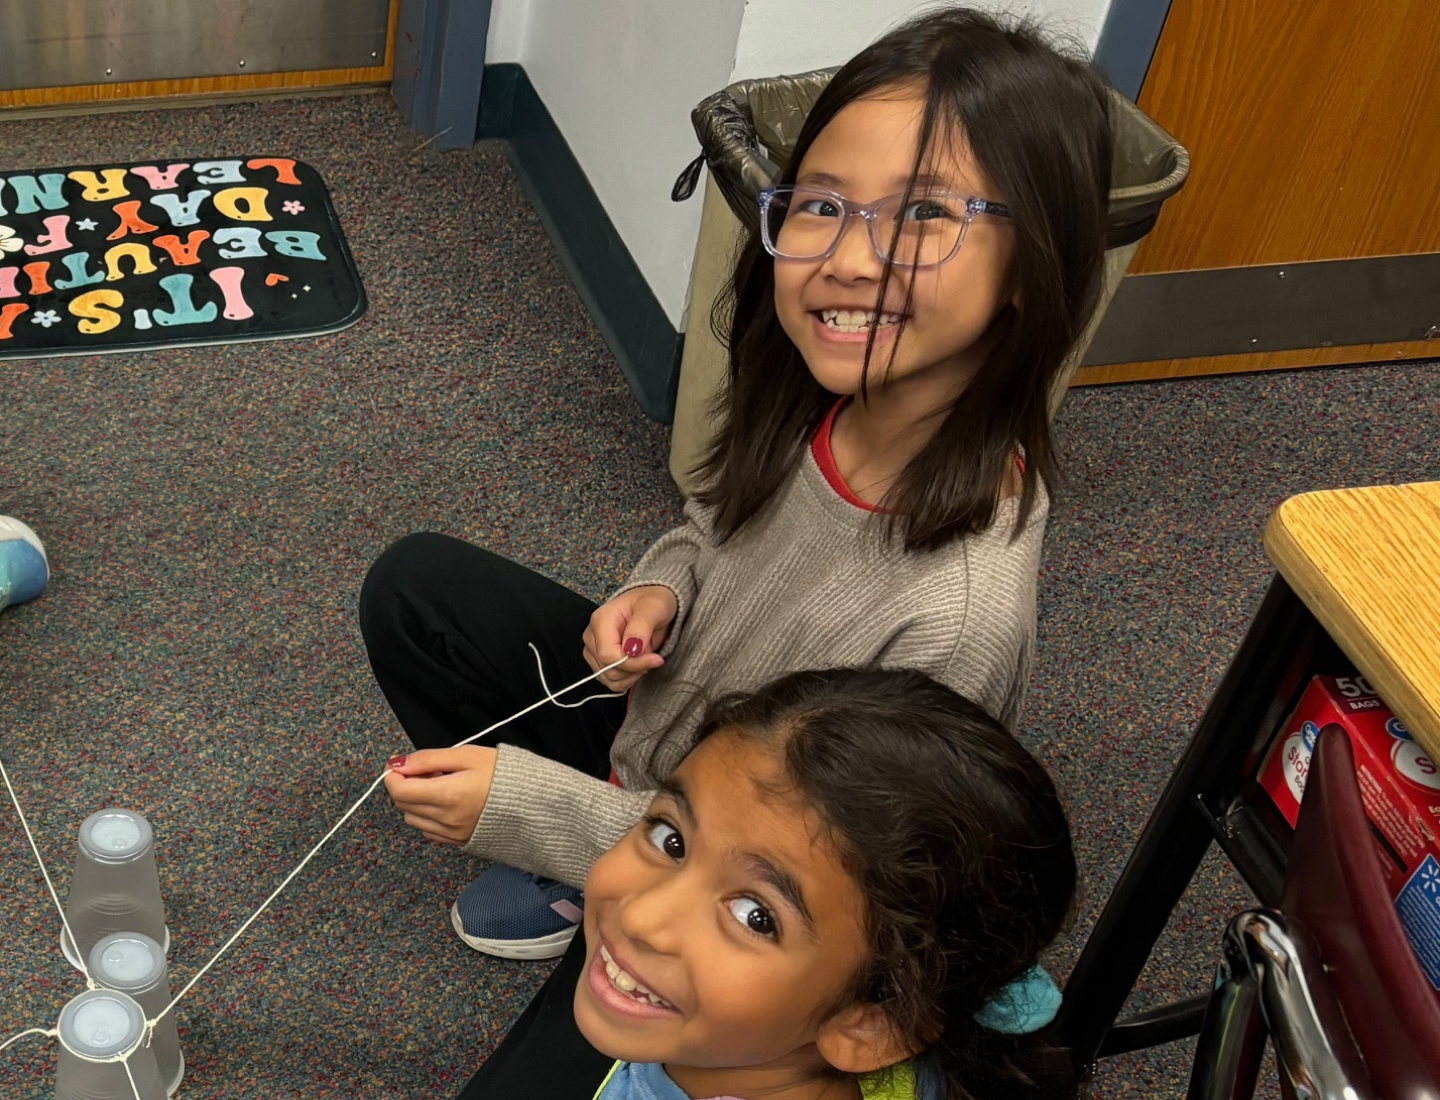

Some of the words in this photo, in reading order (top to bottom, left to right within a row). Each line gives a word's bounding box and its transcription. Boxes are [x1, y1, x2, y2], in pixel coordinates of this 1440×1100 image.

[106, 187, 274, 241] DAY
[68, 266, 254, 334] IT'S
[1349, 699, 1380, 710] BAGS
